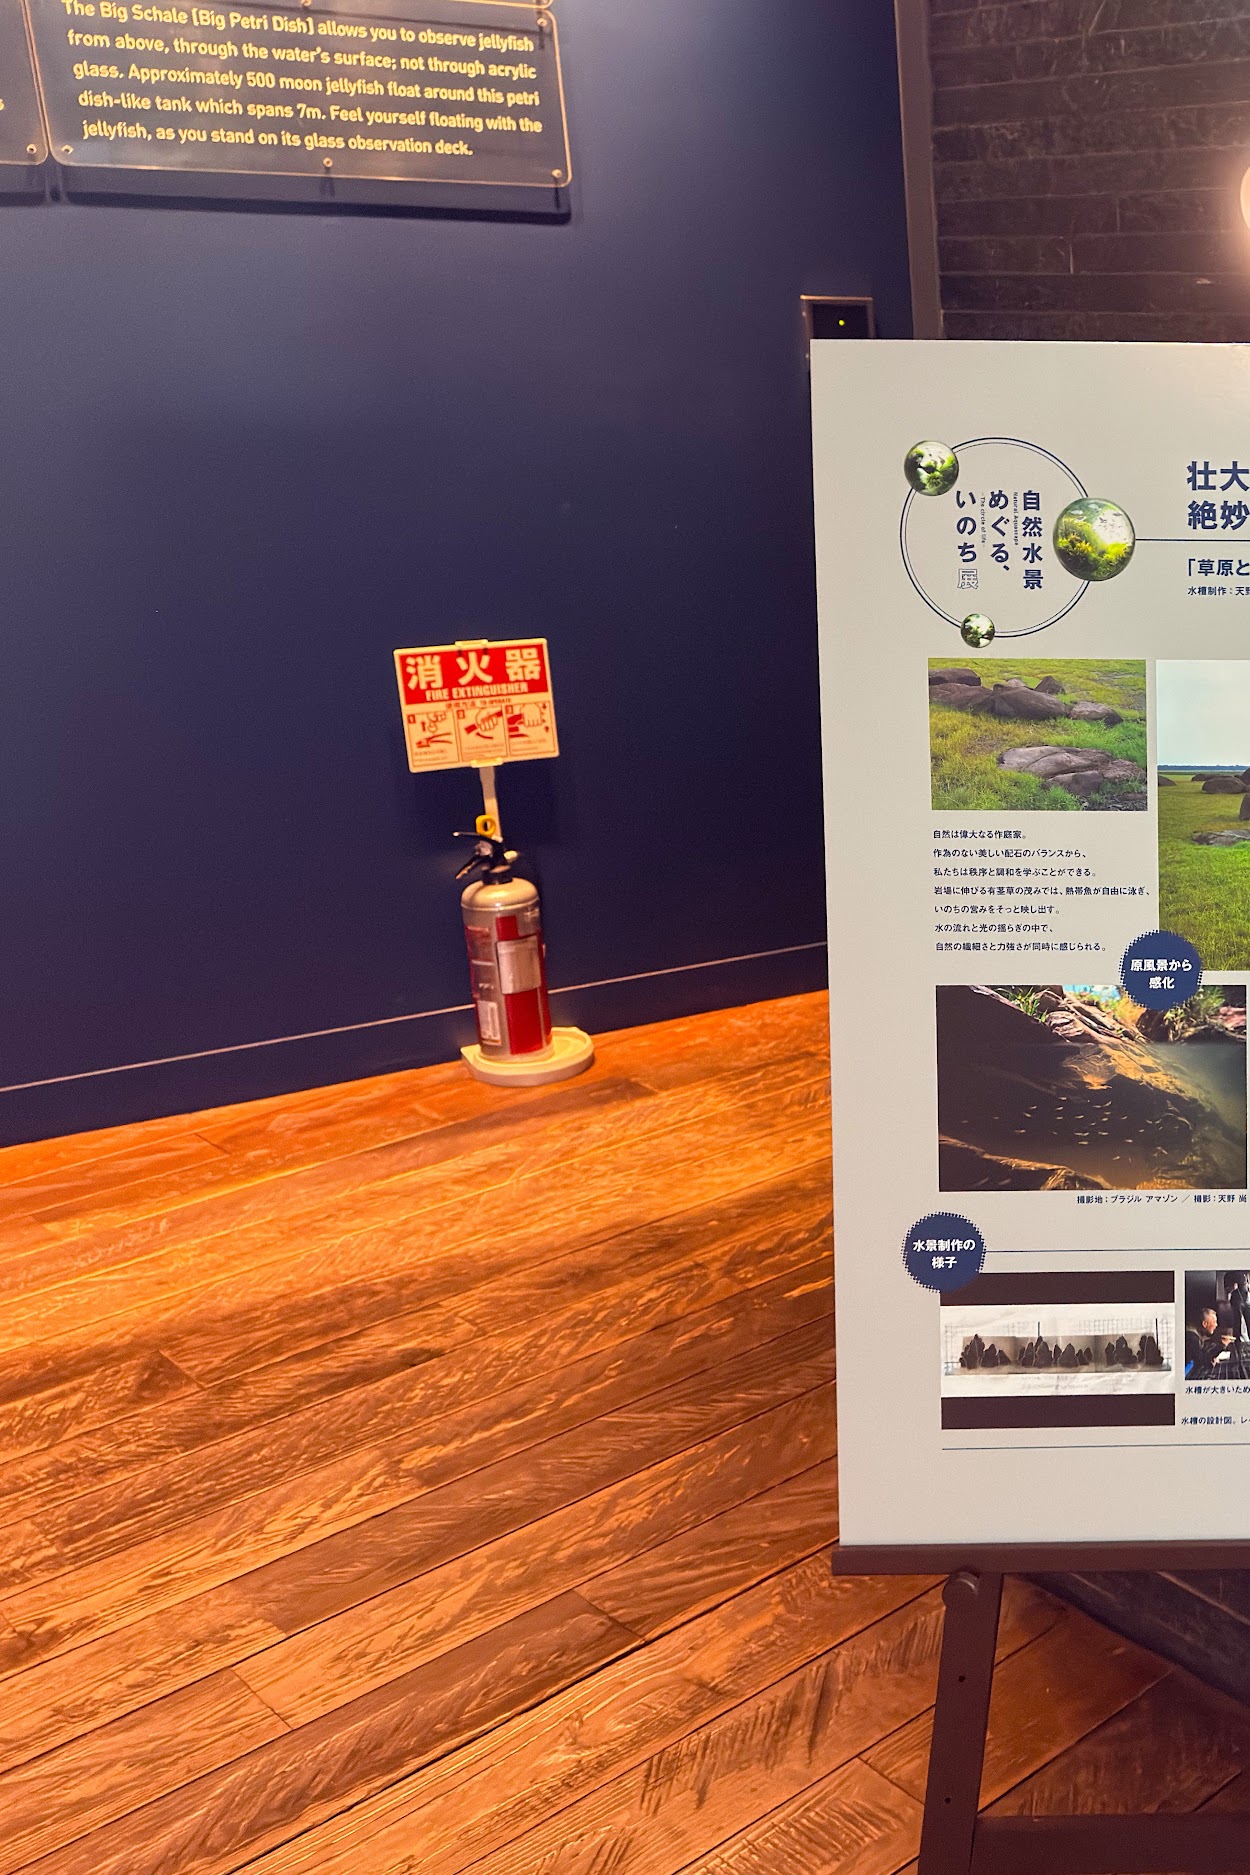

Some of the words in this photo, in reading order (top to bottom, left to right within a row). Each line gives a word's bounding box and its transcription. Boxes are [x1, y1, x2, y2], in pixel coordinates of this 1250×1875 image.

[61, 0, 95, 17] The
[100, 0, 128, 23] Big
[132, 4, 187, 25] Schale
[230, 12, 267, 29] Petri
[318, 22, 368, 39] allows
[370, 27, 397, 42] you
[400, 28, 415, 43] to
[419, 30, 476, 47] observe
[479, 34, 533, 52] jellyfish
[68, 29, 110, 47] from
[173, 38, 238, 60] through
[242, 43, 268, 59] the
[400, 57, 424, 71] not
[428, 57, 485, 78] through
[488, 64, 535, 81] acrylic
[128, 64, 242, 89] Approximately
[247, 71, 275, 88] 500
[279, 77, 322, 91] moon
[326, 78, 384, 97] jellyfish
[387, 81, 421, 97] float
[424, 87, 474, 102] around
[477, 88, 504, 104] this
[507, 92, 539, 106] petri
[78, 91, 151, 109] dish-like
[155, 96, 191, 111] tank
[196, 97, 242, 114] which
[247, 104, 293, 118] spans
[330, 105, 362, 122] Feel
[366, 111, 425, 126] yourself
[429, 112, 483, 132] floating
[486, 116, 516, 131] with
[520, 118, 542, 132] the
[156, 128, 174, 140] as
[179, 129, 207, 143] you
[211, 129, 253, 144] stand
[258, 133, 277, 145] on
[281, 132, 301, 146] its
[304, 133, 344, 151] glass
[348, 135, 432, 153] observation
[956, 489, 979, 590] いのち展
[988, 489, 1010, 571] めぐる、
[1022, 489, 1044, 590] 自然水景
[405, 647, 542, 690] 消火器
[425, 688, 449, 702] FIRE
[452, 682, 529, 699] EXTINGUISHER
[933, 829, 1027, 840] 自然は偉大なる作庭家。
[933, 848, 1087, 858] 作為のない美しい配石のバランスから、
[934, 905, 1060, 915] いのちの営みをそっと映し出す。
[935, 923, 1054, 933] 水の流れと光の揺らぎの中で、
[1130, 958, 1192, 972] 原風景から
[1148, 976, 1175, 990] 感化
[912, 1239, 976, 1252] 水景制作の
[931, 1256, 957, 1269] 様子
